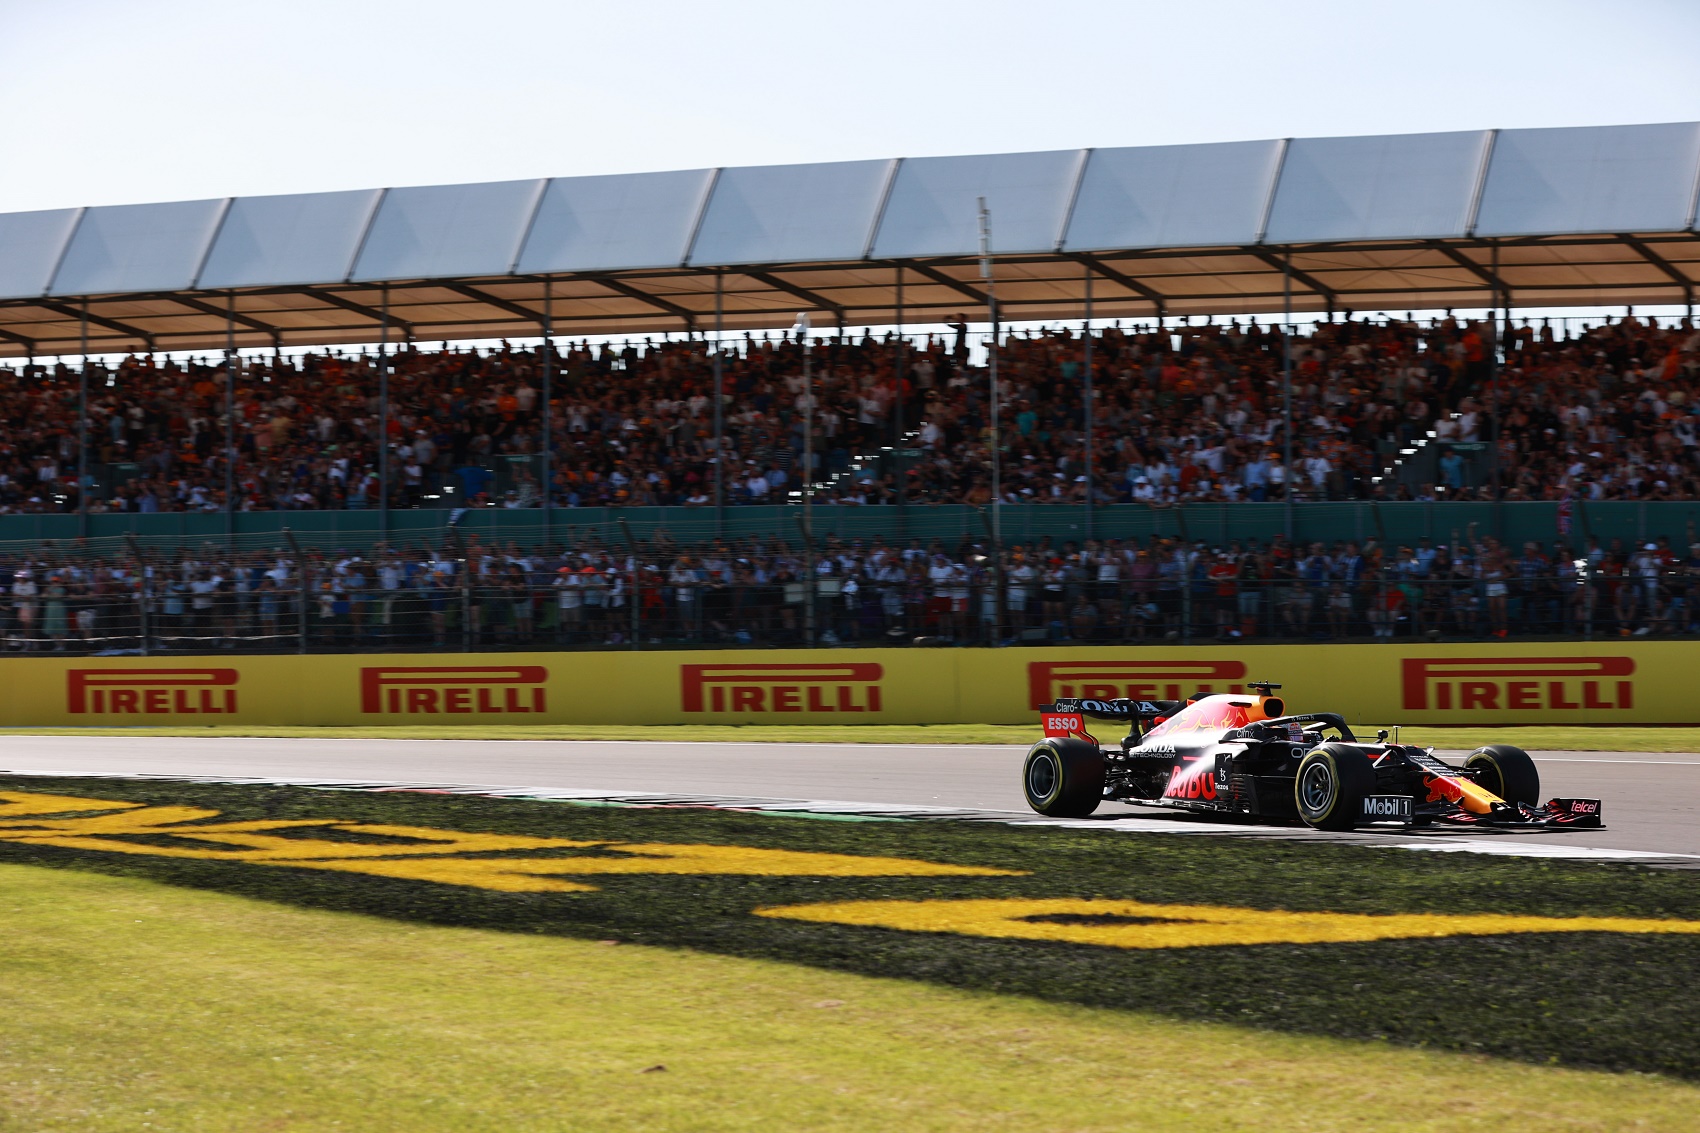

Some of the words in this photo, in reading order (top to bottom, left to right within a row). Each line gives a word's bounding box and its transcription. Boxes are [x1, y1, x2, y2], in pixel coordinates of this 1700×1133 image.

[67, 668, 239, 713] PIRELLI
[360, 666, 549, 713] PIRELLI
[680, 663, 884, 712] PIRELLI
[1401, 657, 1636, 710] PIRELLI
[1081, 700, 1162, 713] ONA
[1048, 717, 1079, 730] ESSO
[1364, 797, 1399, 815] Mobil
[1570, 800, 1598, 813] telcel
